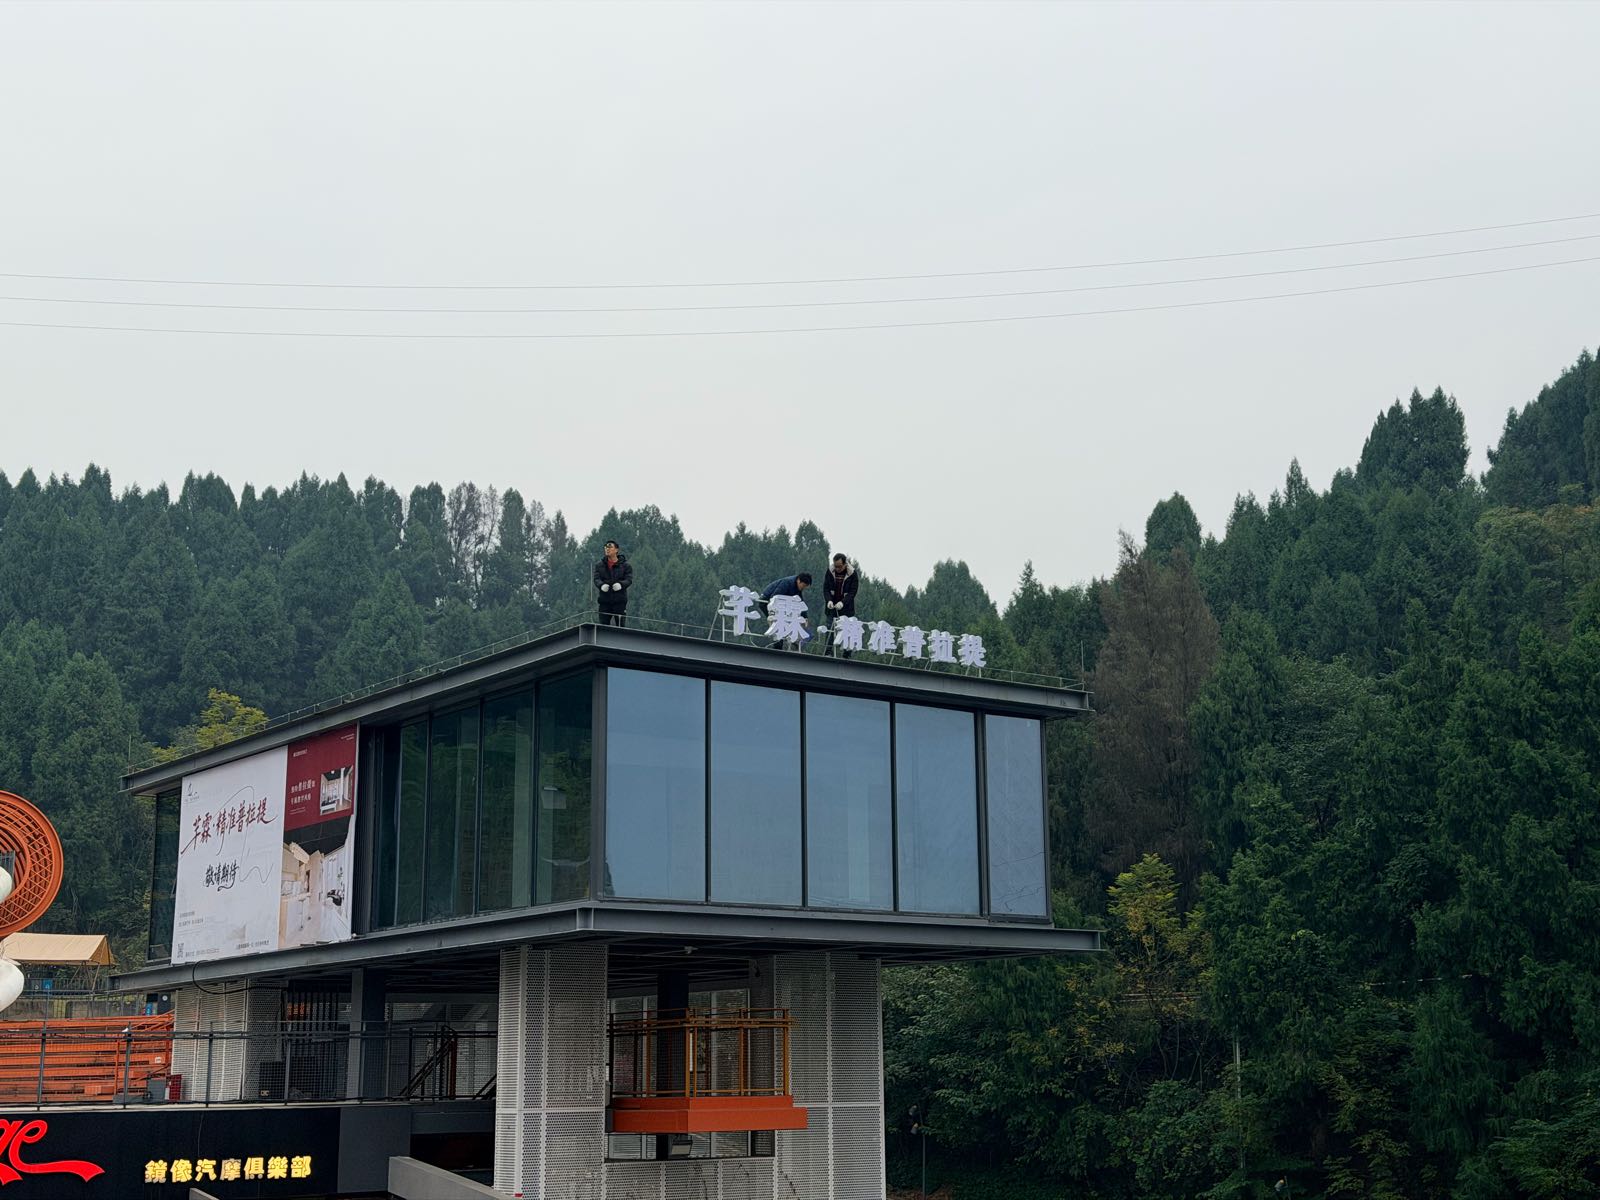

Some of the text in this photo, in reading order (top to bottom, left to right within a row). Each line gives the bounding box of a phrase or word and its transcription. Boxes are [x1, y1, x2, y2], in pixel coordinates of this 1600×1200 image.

[206, 859, 240, 892] 敬请期待
[144, 1155, 312, 1184] 鏡像汽摩俱樂部
